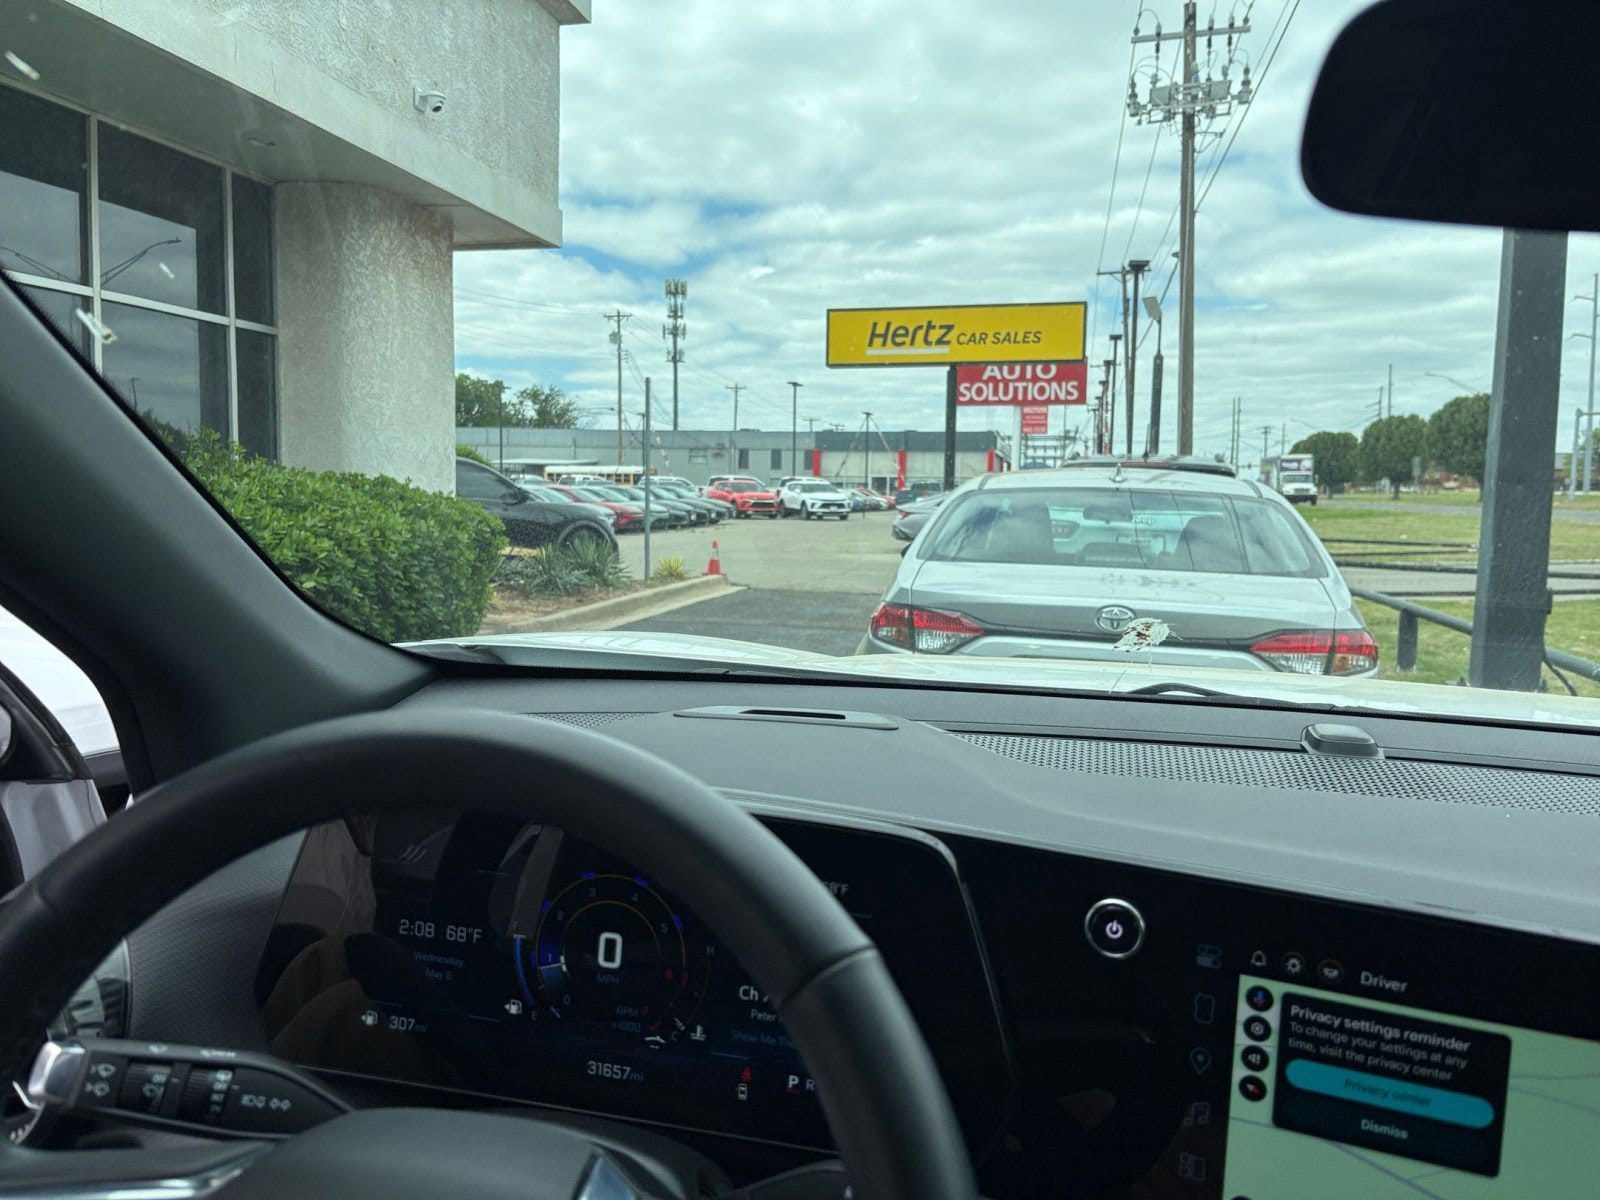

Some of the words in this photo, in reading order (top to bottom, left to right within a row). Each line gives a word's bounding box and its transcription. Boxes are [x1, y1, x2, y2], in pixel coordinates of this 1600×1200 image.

[868, 320, 955, 347] Hertz
[956, 332, 988, 346] CAR
[991, 330, 1042, 344] SALES
[958, 381, 1079, 402] SOLUTIONS
[399, 918, 435, 938] 2:08
[446, 924, 483, 943] 68°F
[414, 951, 464, 968] Wednesday
[597, 931, 623, 969] 0
[1360, 970, 1409, 994] Driver
[750, 1008, 777, 1022] Peter
[1290, 1004, 1342, 1028] Privacy
[1344, 1017, 1401, 1041] settings
[1403, 1029, 1472, 1052] reminder
[1290, 1021, 1304, 1034] To
[1305, 1023, 1348, 1044] change
[1351, 1036, 1378, 1049] your
[1380, 1039, 1428, 1061] settings
[1430, 1049, 1442, 1061] at
[1445, 1054, 1468, 1069] any
[1288, 1036, 1316, 1052] time,
[1320, 1044, 1343, 1057] visit
[1345, 1048, 1365, 1061] the
[1367, 1055, 1412, 1074] privacy
[1413, 1062, 1453, 1080] center
[787, 1074, 800, 1089] P
[1344, 1078, 1388, 1098] Privacy
[1361, 1118, 1409, 1140] Dismiss
